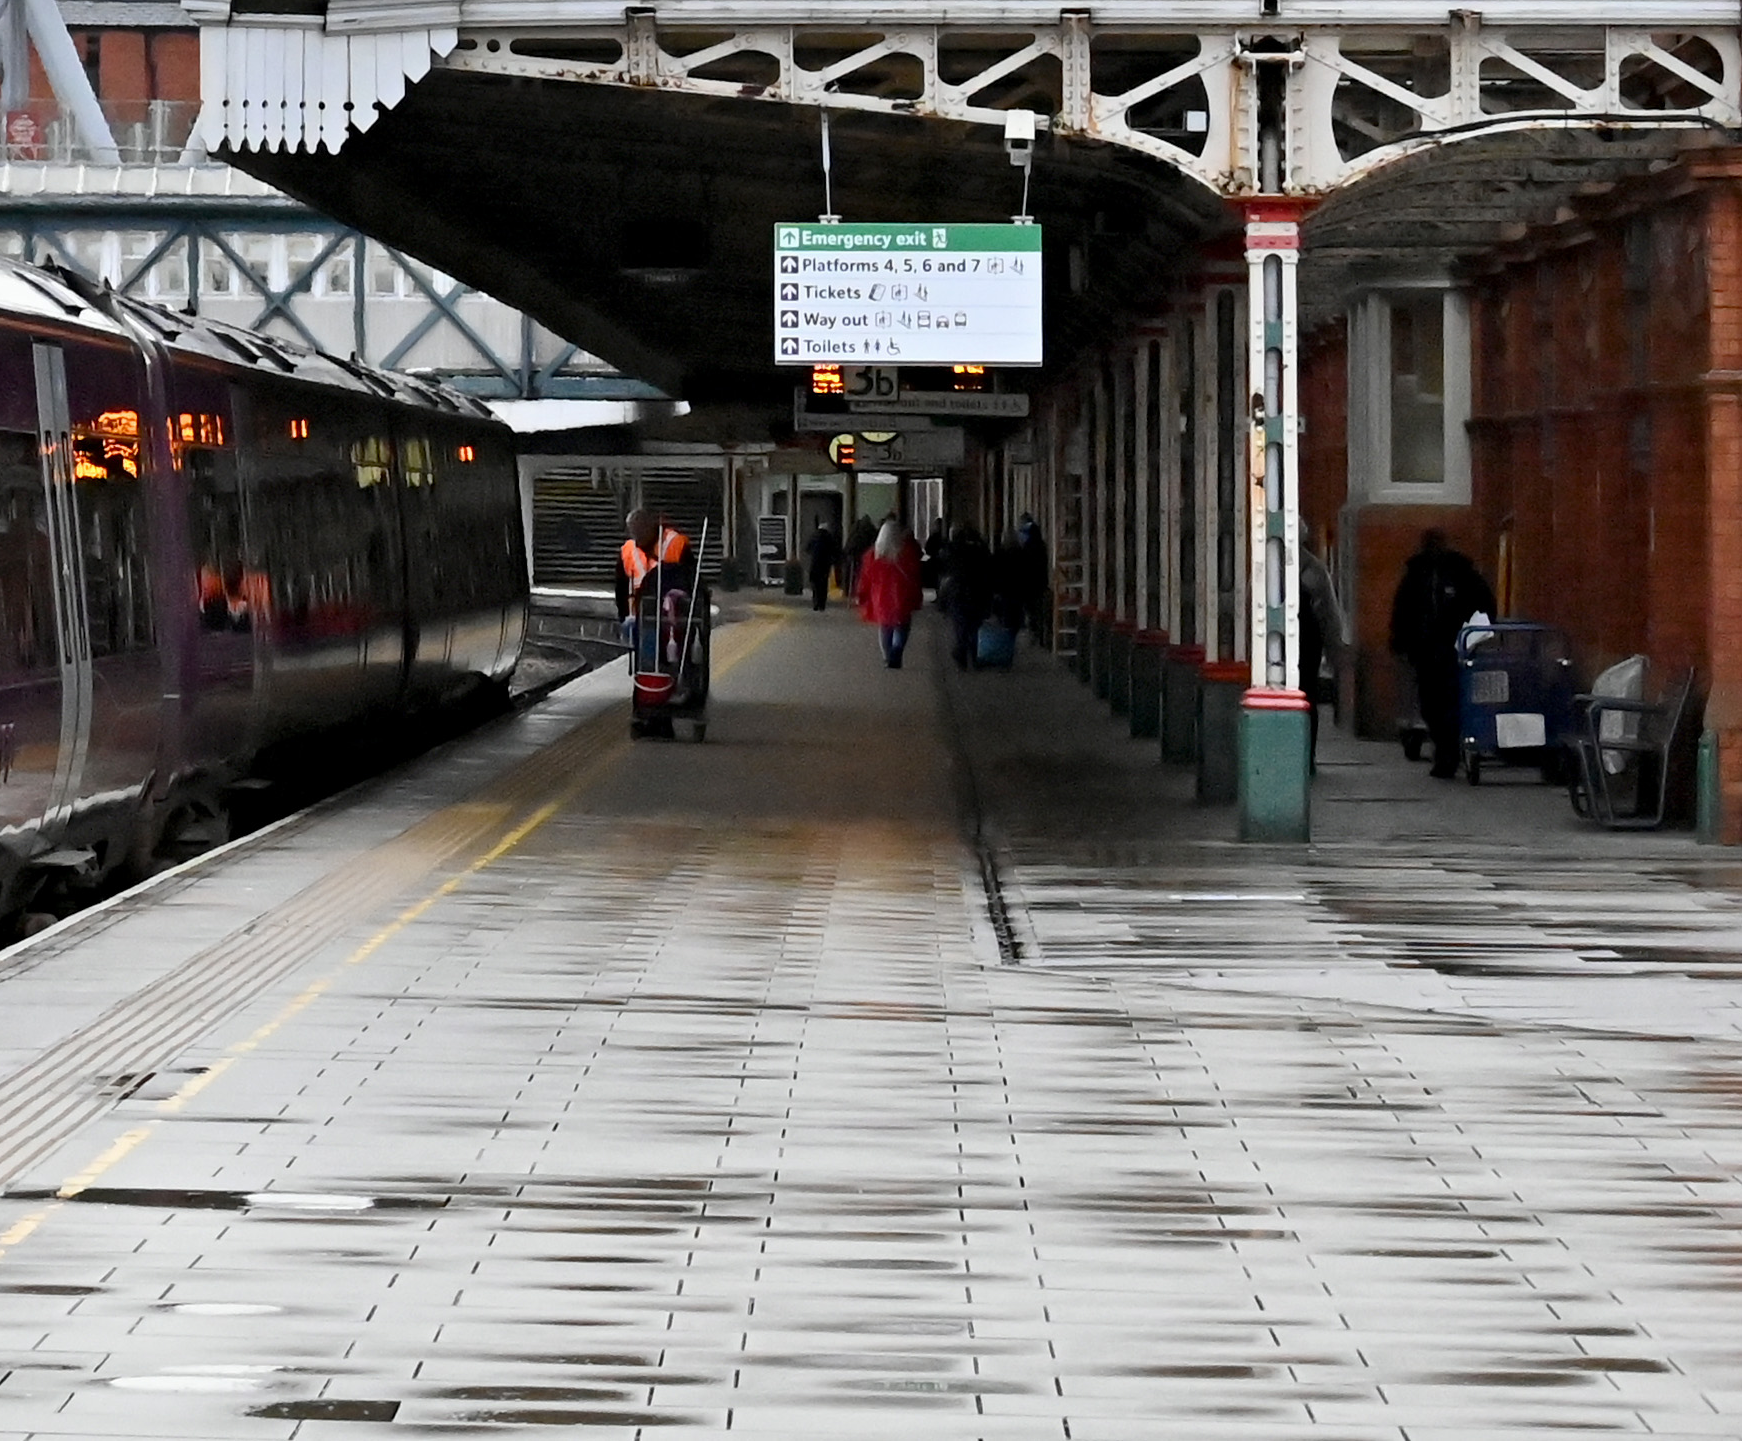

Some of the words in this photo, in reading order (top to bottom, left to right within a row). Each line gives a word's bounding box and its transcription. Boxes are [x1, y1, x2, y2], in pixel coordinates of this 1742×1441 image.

[802, 230, 892, 249] Emergency
[896, 231, 927, 246] exit
[803, 258, 879, 272] Platforms
[884, 259, 898, 274] 4,
[903, 259, 917, 274] 5,
[922, 259, 932, 272] 6
[937, 259, 966, 272] and
[971, 259, 981, 272] 7
[804, 285, 861, 299] Tickets
[804, 312, 836, 329] Way
[842, 315, 869, 326] out
[804, 340, 856, 353] Toilets
